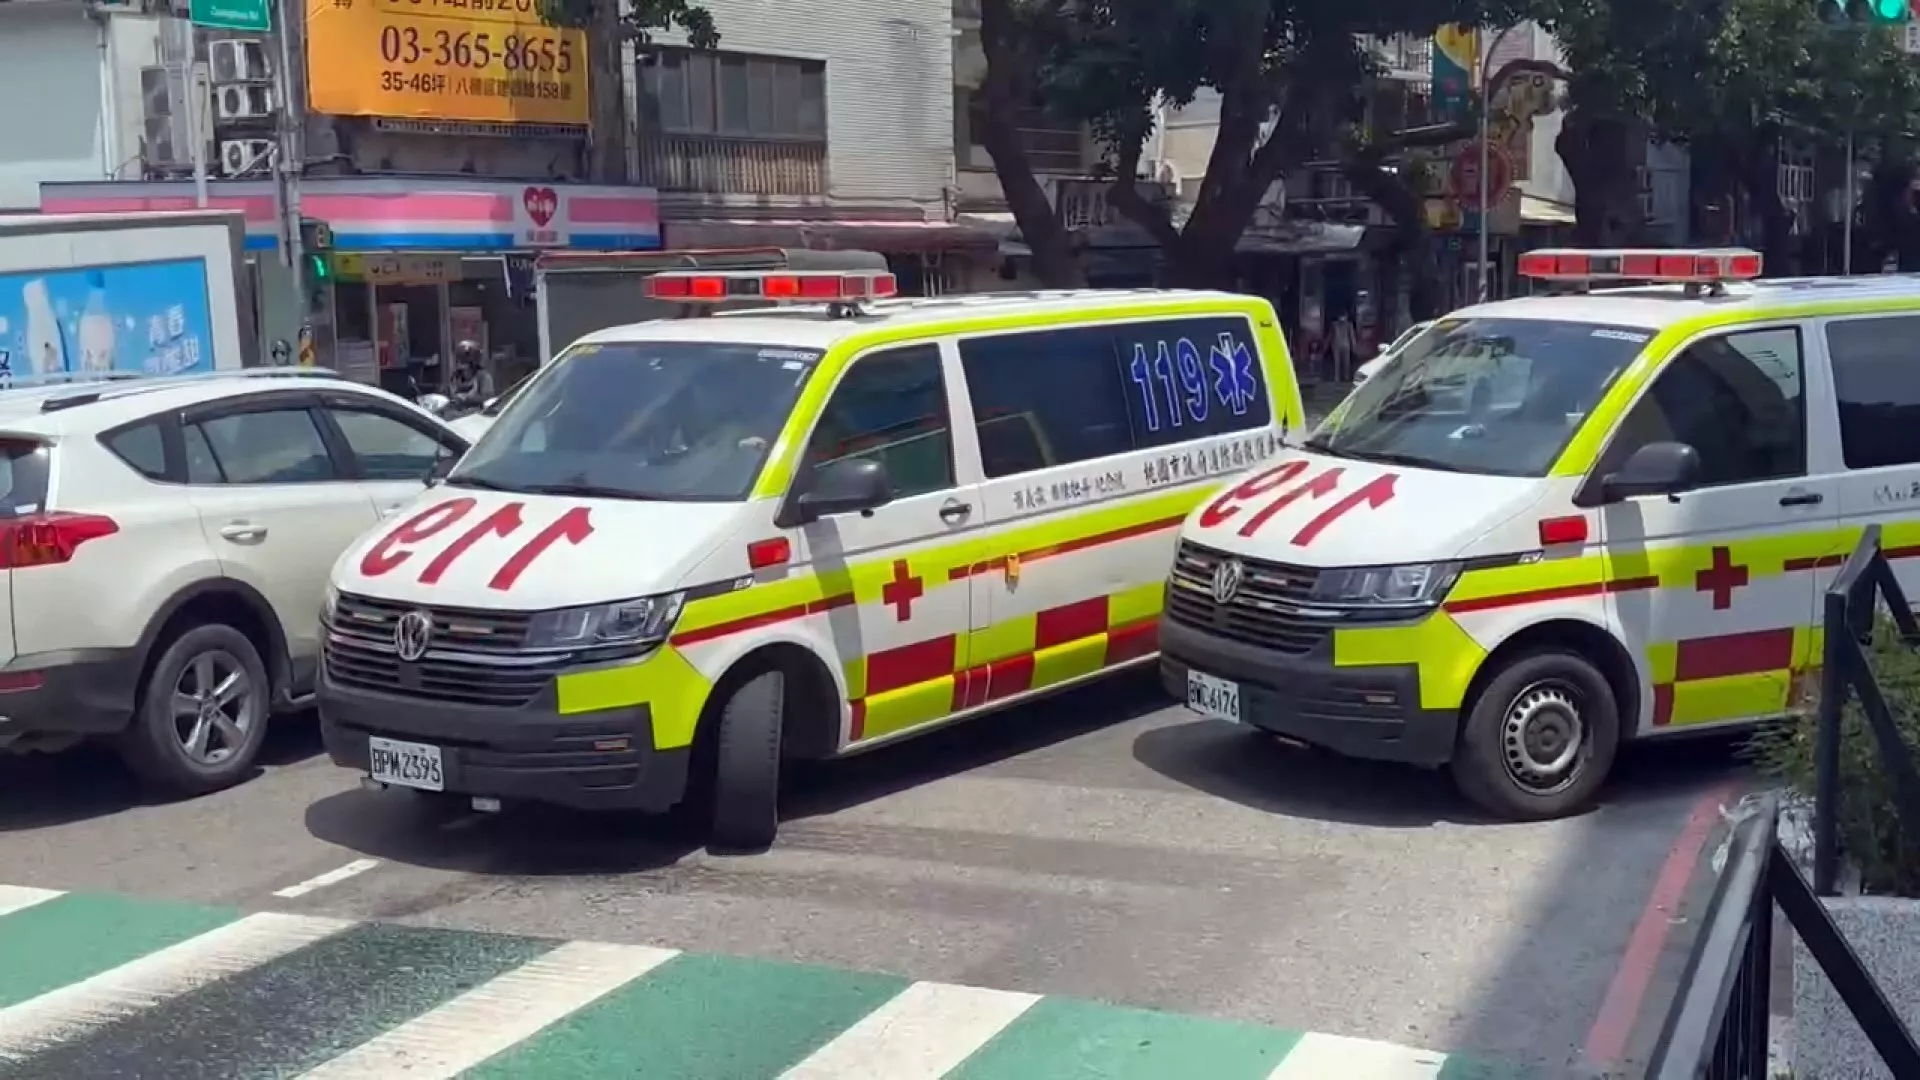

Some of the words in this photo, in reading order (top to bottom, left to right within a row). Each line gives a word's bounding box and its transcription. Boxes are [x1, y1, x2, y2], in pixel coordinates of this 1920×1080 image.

[381, 25, 571, 74] 03-365-8655
[381, 71, 446, 96] 35-46坪
[1131, 337, 1208, 431] 119
